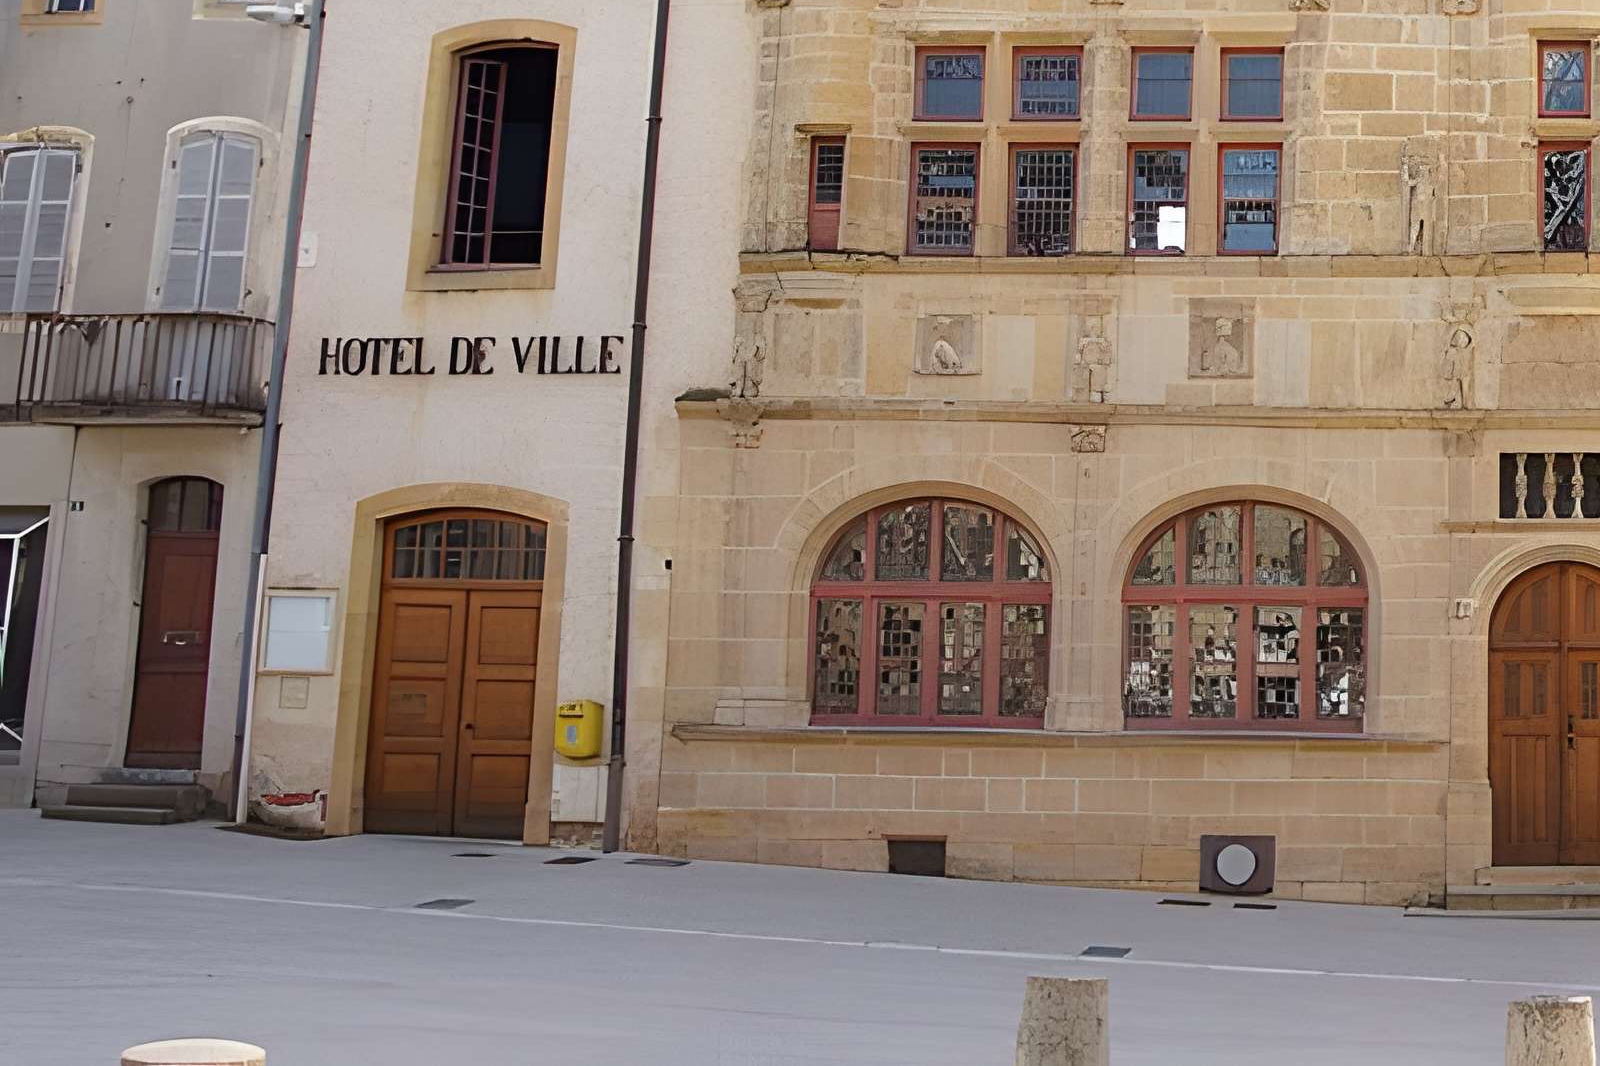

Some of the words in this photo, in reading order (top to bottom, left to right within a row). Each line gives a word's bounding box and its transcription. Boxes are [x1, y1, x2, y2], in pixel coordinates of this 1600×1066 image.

[318, 337, 435, 376] HOTEL
[449, 336, 496, 375] DE
[511, 335, 624, 375] VILLE
